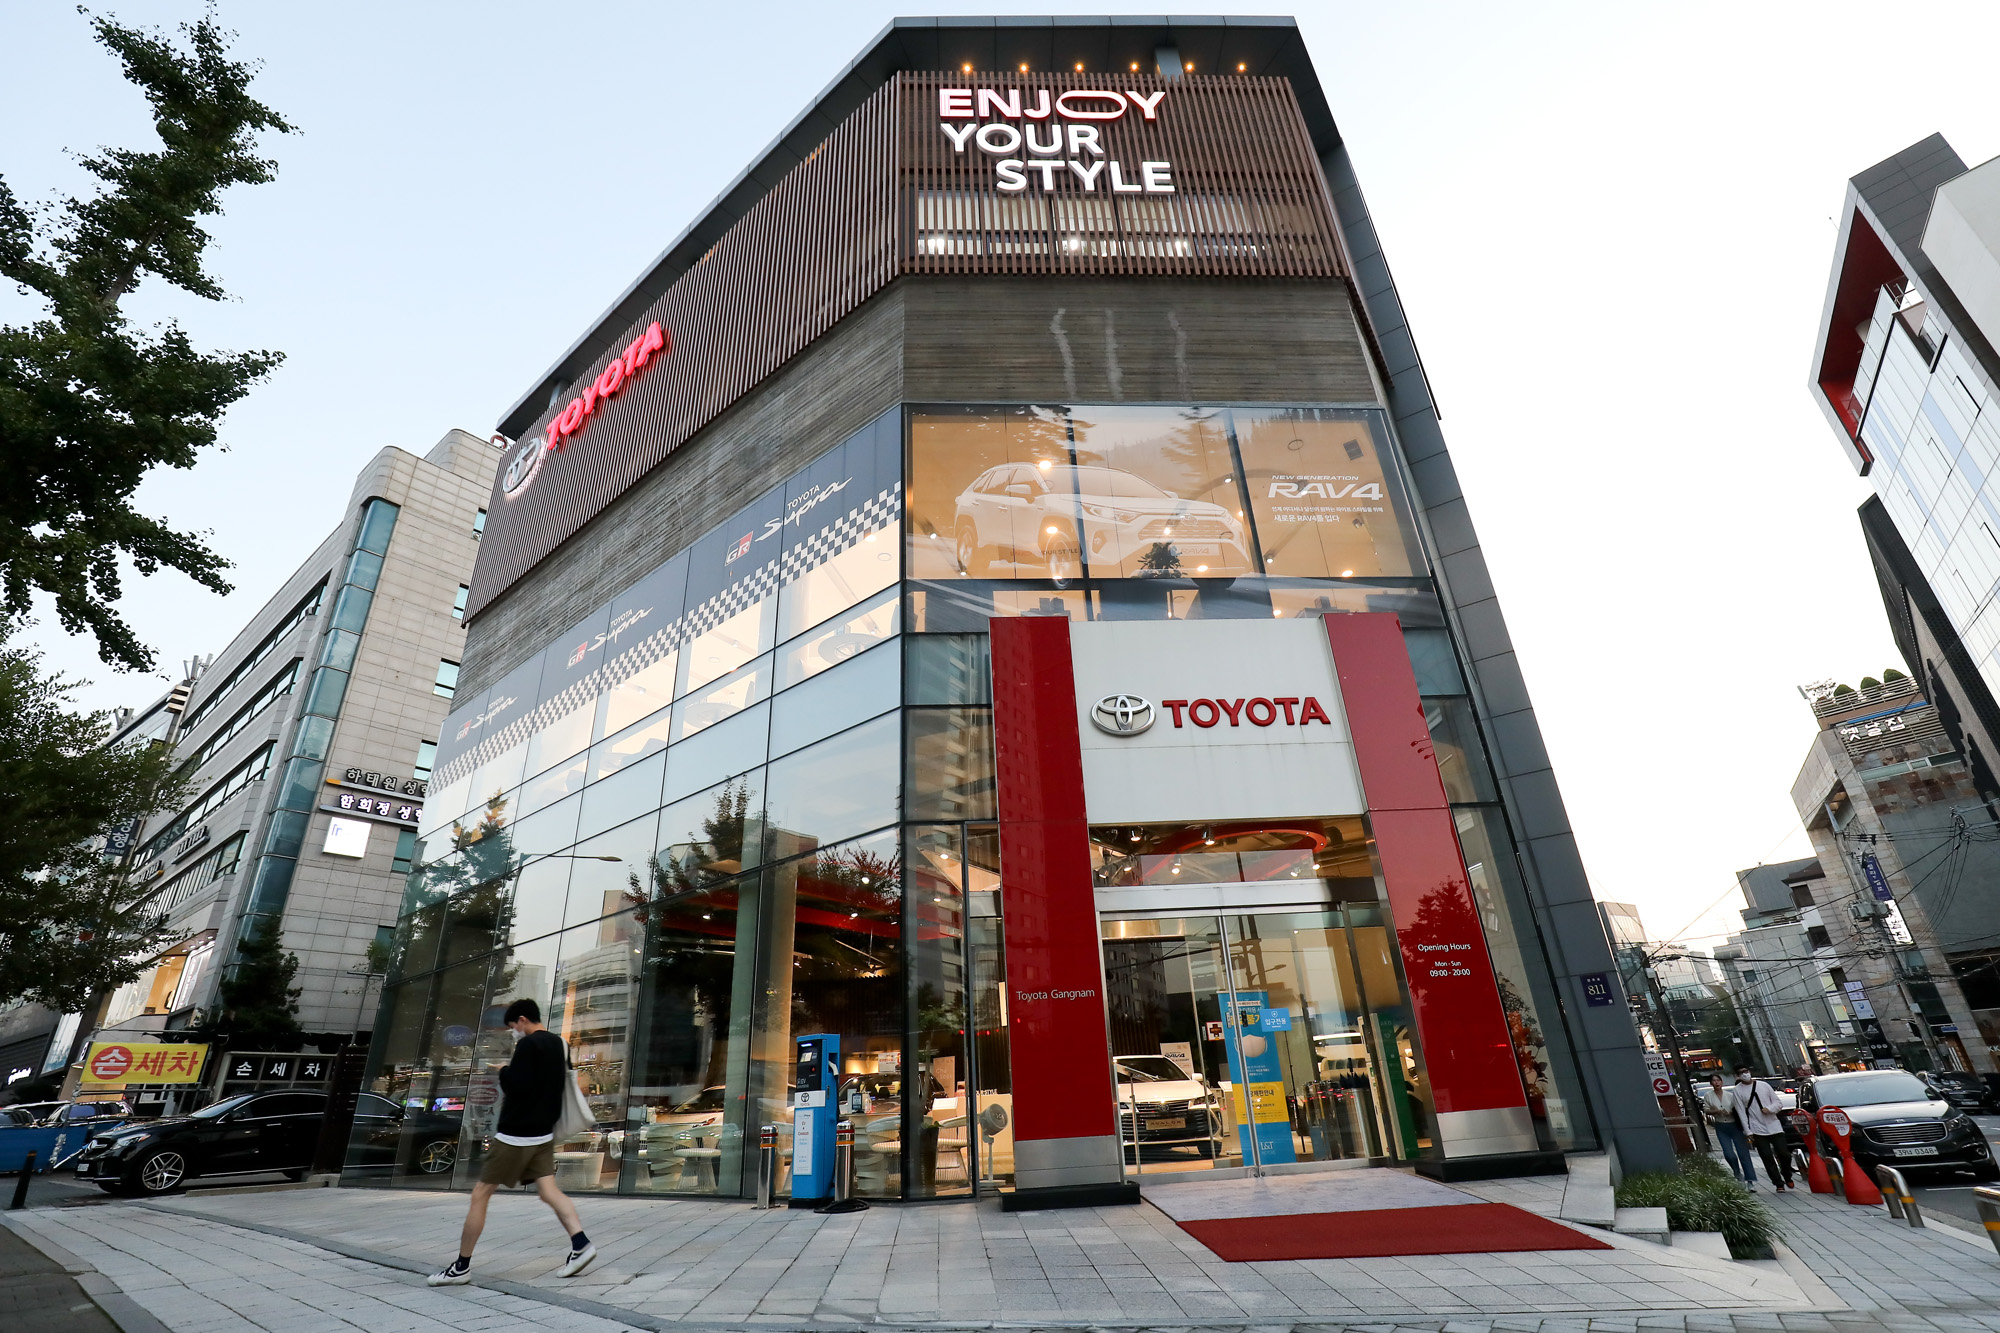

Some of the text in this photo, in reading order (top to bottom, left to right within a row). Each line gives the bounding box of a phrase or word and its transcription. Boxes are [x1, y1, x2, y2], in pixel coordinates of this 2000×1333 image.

[939, 88, 1166, 120] ENJOY
[940, 122, 1104, 156] YOUR
[995, 158, 1176, 195] STYLE
[546, 321, 664, 450] TOYOTA
[787, 484, 820, 511] TOYOTA
[1268, 482, 1384, 501] RAV4
[726, 477, 852, 562] GR Supra
[1274, 514, 1297, 522] 새로운
[1297, 514, 1324, 522] RAV4를
[610, 608, 633, 628] TOYOTA
[568, 607, 653, 668] GR Supra
[471, 696, 518, 728] Supra
[1162, 696, 1331, 728] TOYOTA
[1840, 716, 1906, 742] 옛날집
[347, 767, 397, 791] 하태원
[340, 794, 391, 816] 함희정
[1418, 944, 1449, 952] Opening
[1016, 989, 1095, 1002] Toyota Gangnam
[1587, 983, 1607, 995] 811
[1264, 1017, 1287, 1025] 입구전용
[94, 1048, 199, 1077] 손세차
[1646, 1061, 1665, 1070] ICE
[1260, 1141, 1274, 1150] L&T
